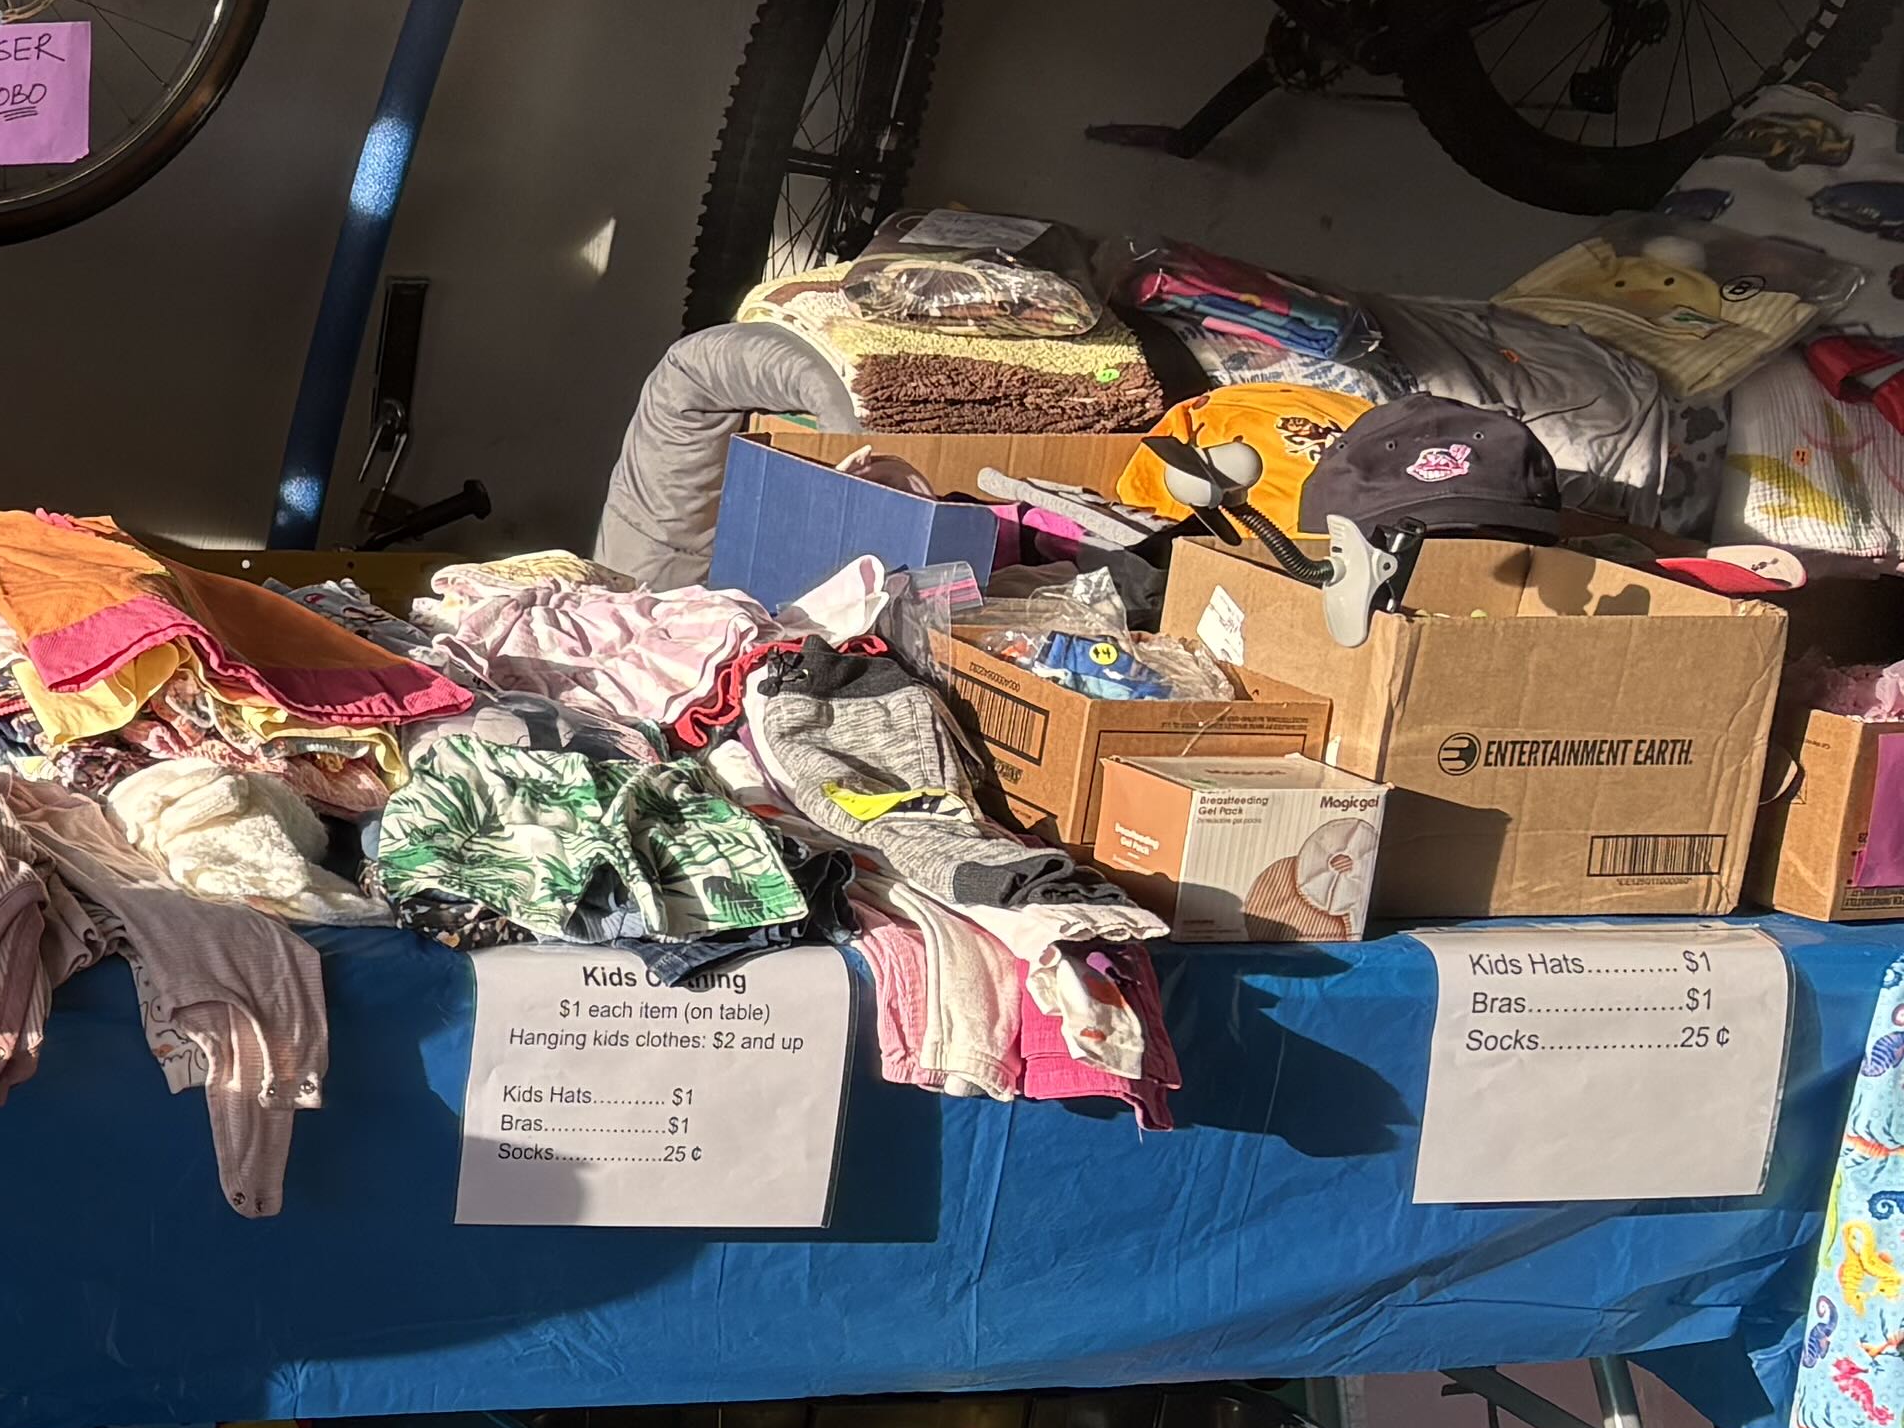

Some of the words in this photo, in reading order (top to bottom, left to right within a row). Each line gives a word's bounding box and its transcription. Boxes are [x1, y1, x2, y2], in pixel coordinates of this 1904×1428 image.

[1482, 738, 1634, 768] ENTERTAINMENT
[1198, 805, 1218, 816] Gel
[1219, 805, 1245, 817] Pack
[1199, 794, 1270, 807] Breastfeeding
[1468, 952, 1524, 976] Kids
[1682, 949, 1712, 973] $1
[582, 965, 638, 990] Kids
[559, 999, 581, 1020] $1
[587, 999, 633, 1021] each
[638, 1001, 679, 1021] item
[683, 1002, 714, 1025] (on
[718, 1001, 771, 1026] table)
[508, 1028, 587, 1052] Hanging
[592, 1029, 630, 1049] kids
[635, 1029, 707, 1050] clothes:
[711, 1030, 736, 1051] $2
[740, 1031, 775, 1052] and
[780, 1035, 804, 1054] up
[502, 1084, 544, 1105] Kids
[671, 1087, 694, 1107] $1
